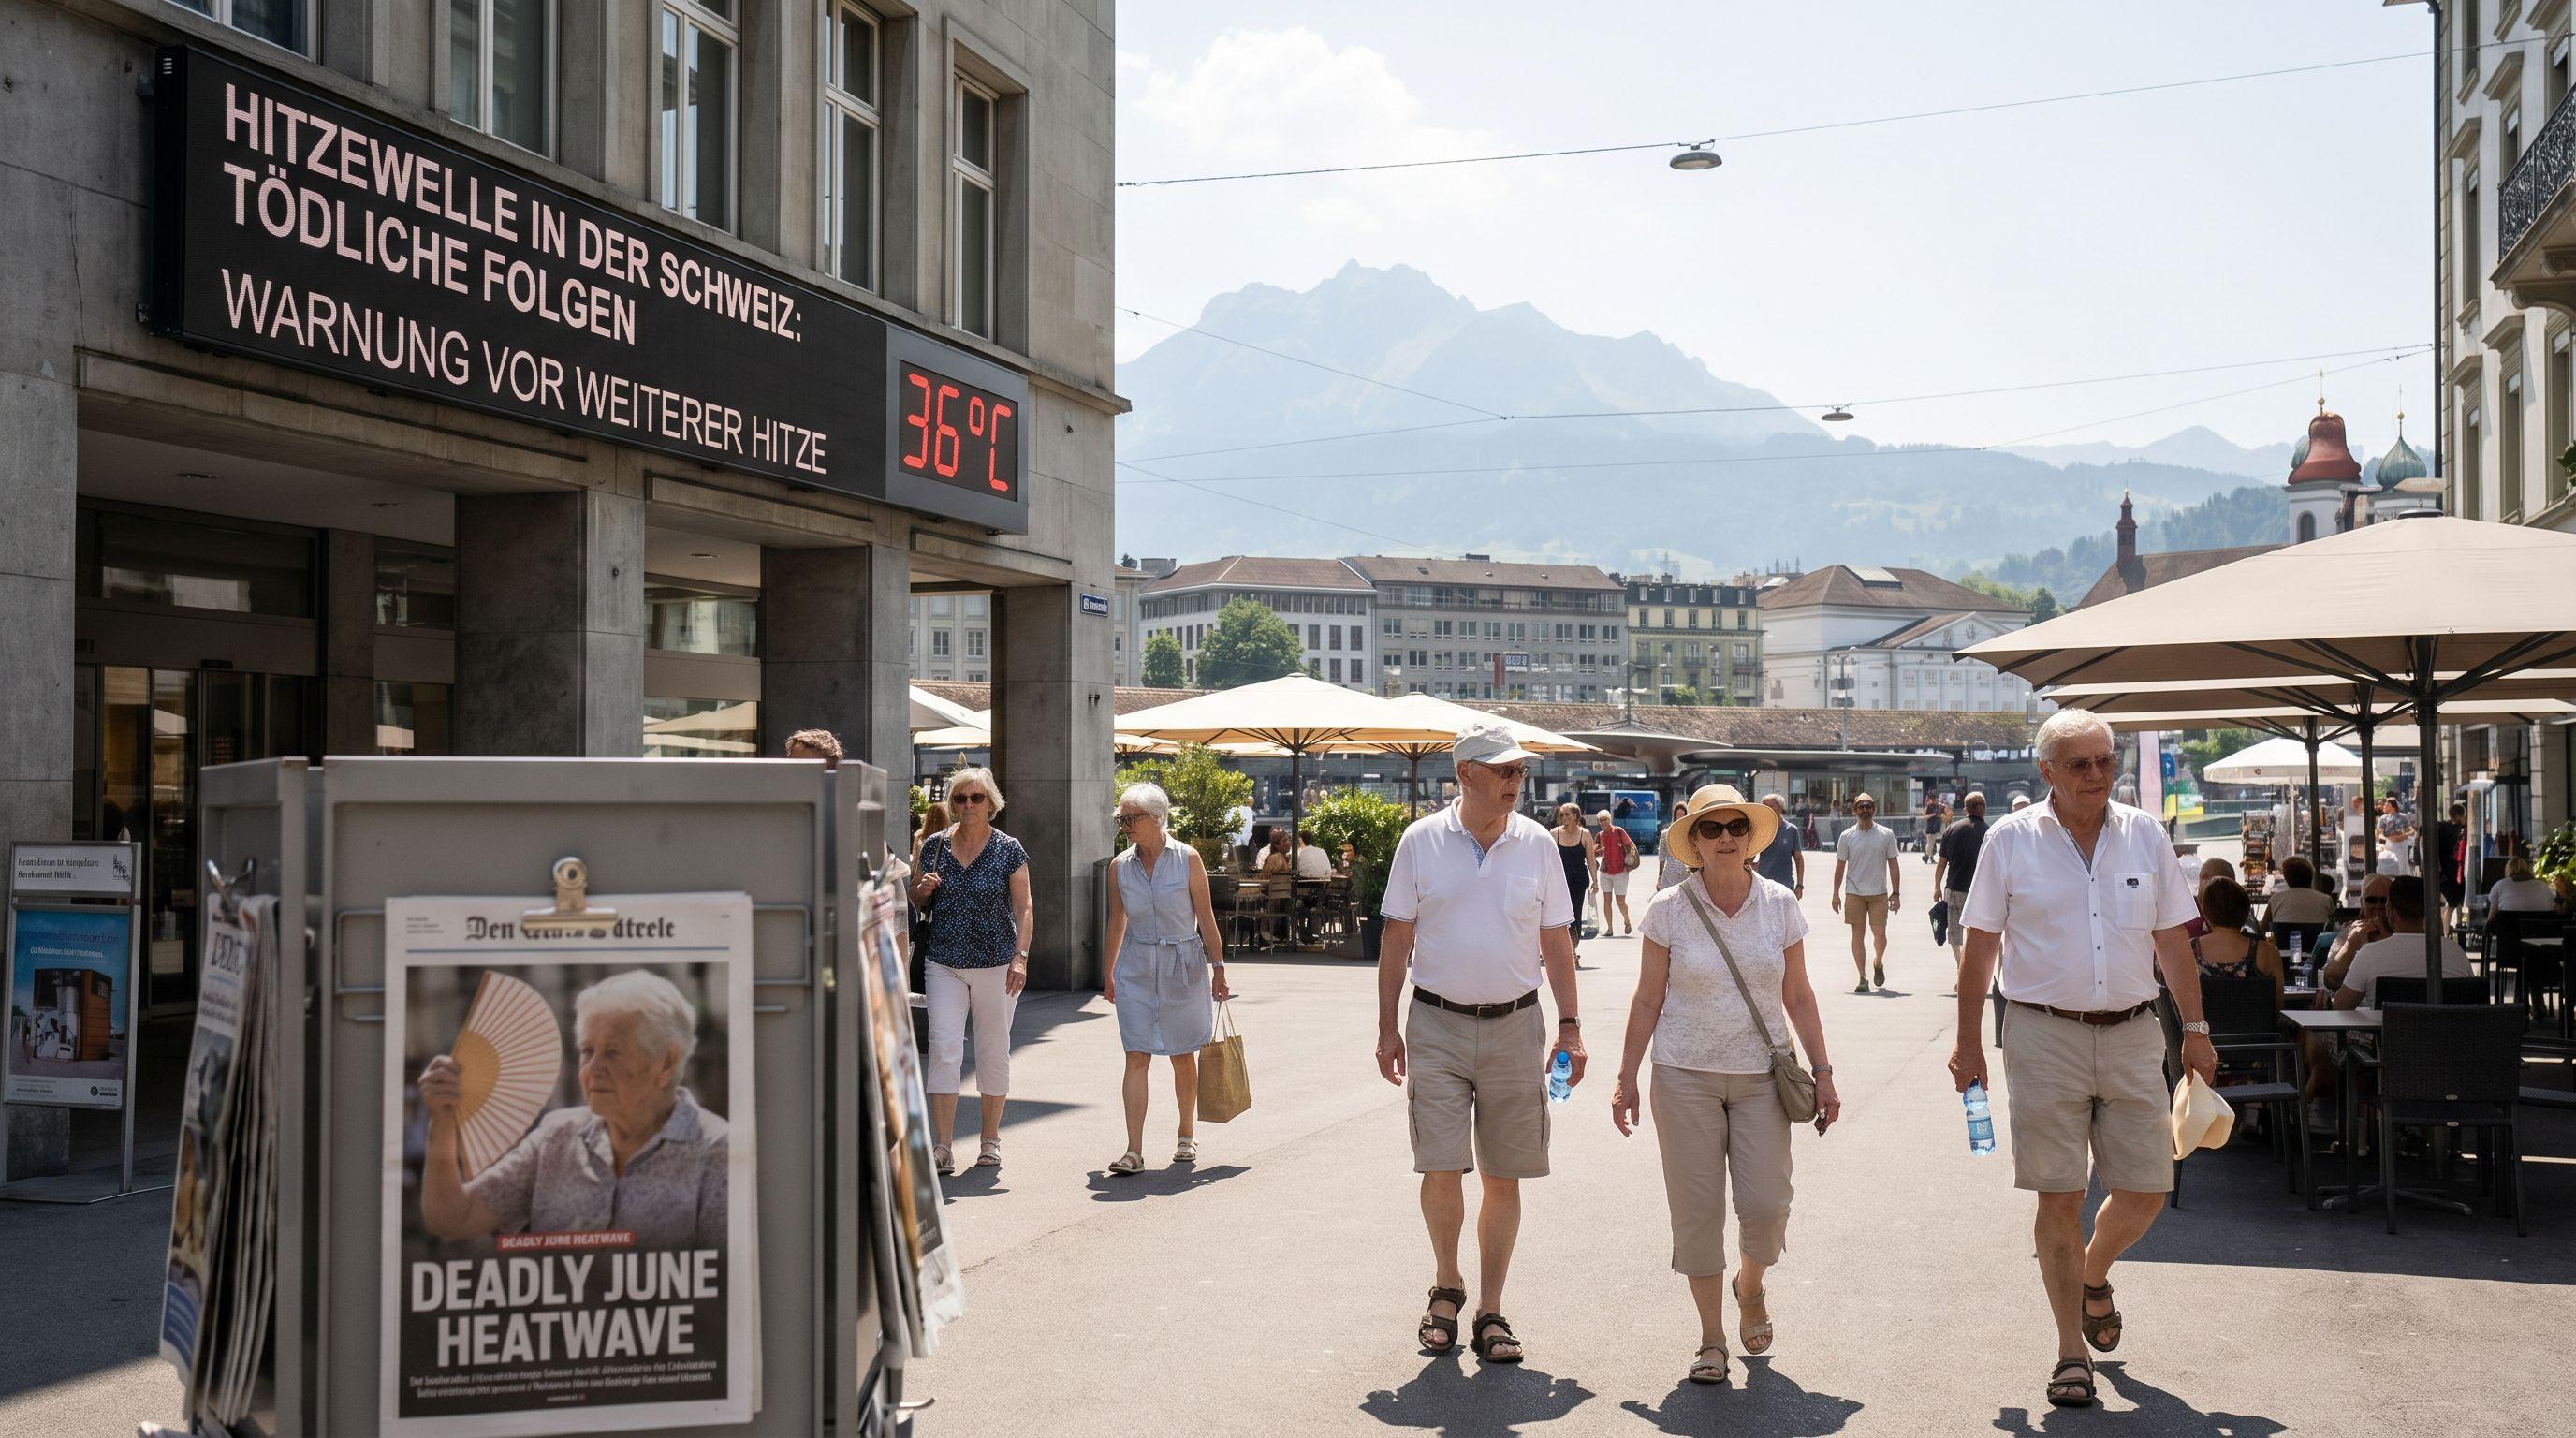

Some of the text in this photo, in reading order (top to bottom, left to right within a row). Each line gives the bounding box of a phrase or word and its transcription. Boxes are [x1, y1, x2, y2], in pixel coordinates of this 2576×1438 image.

[226, 82, 802, 342] HITZEWELLE IN DER SCHWEIZ:
[224, 161, 636, 345] TÖDLICHE FOLGEN
[221, 268, 827, 475] WARNUNG VOR WEITERER HITZE
[466, 916, 514, 941] Den
[502, 1236, 543, 1249] DEADLY
[411, 1249, 719, 1313] DEADLY JUNE
[437, 1305, 695, 1367] HEATWAVE
